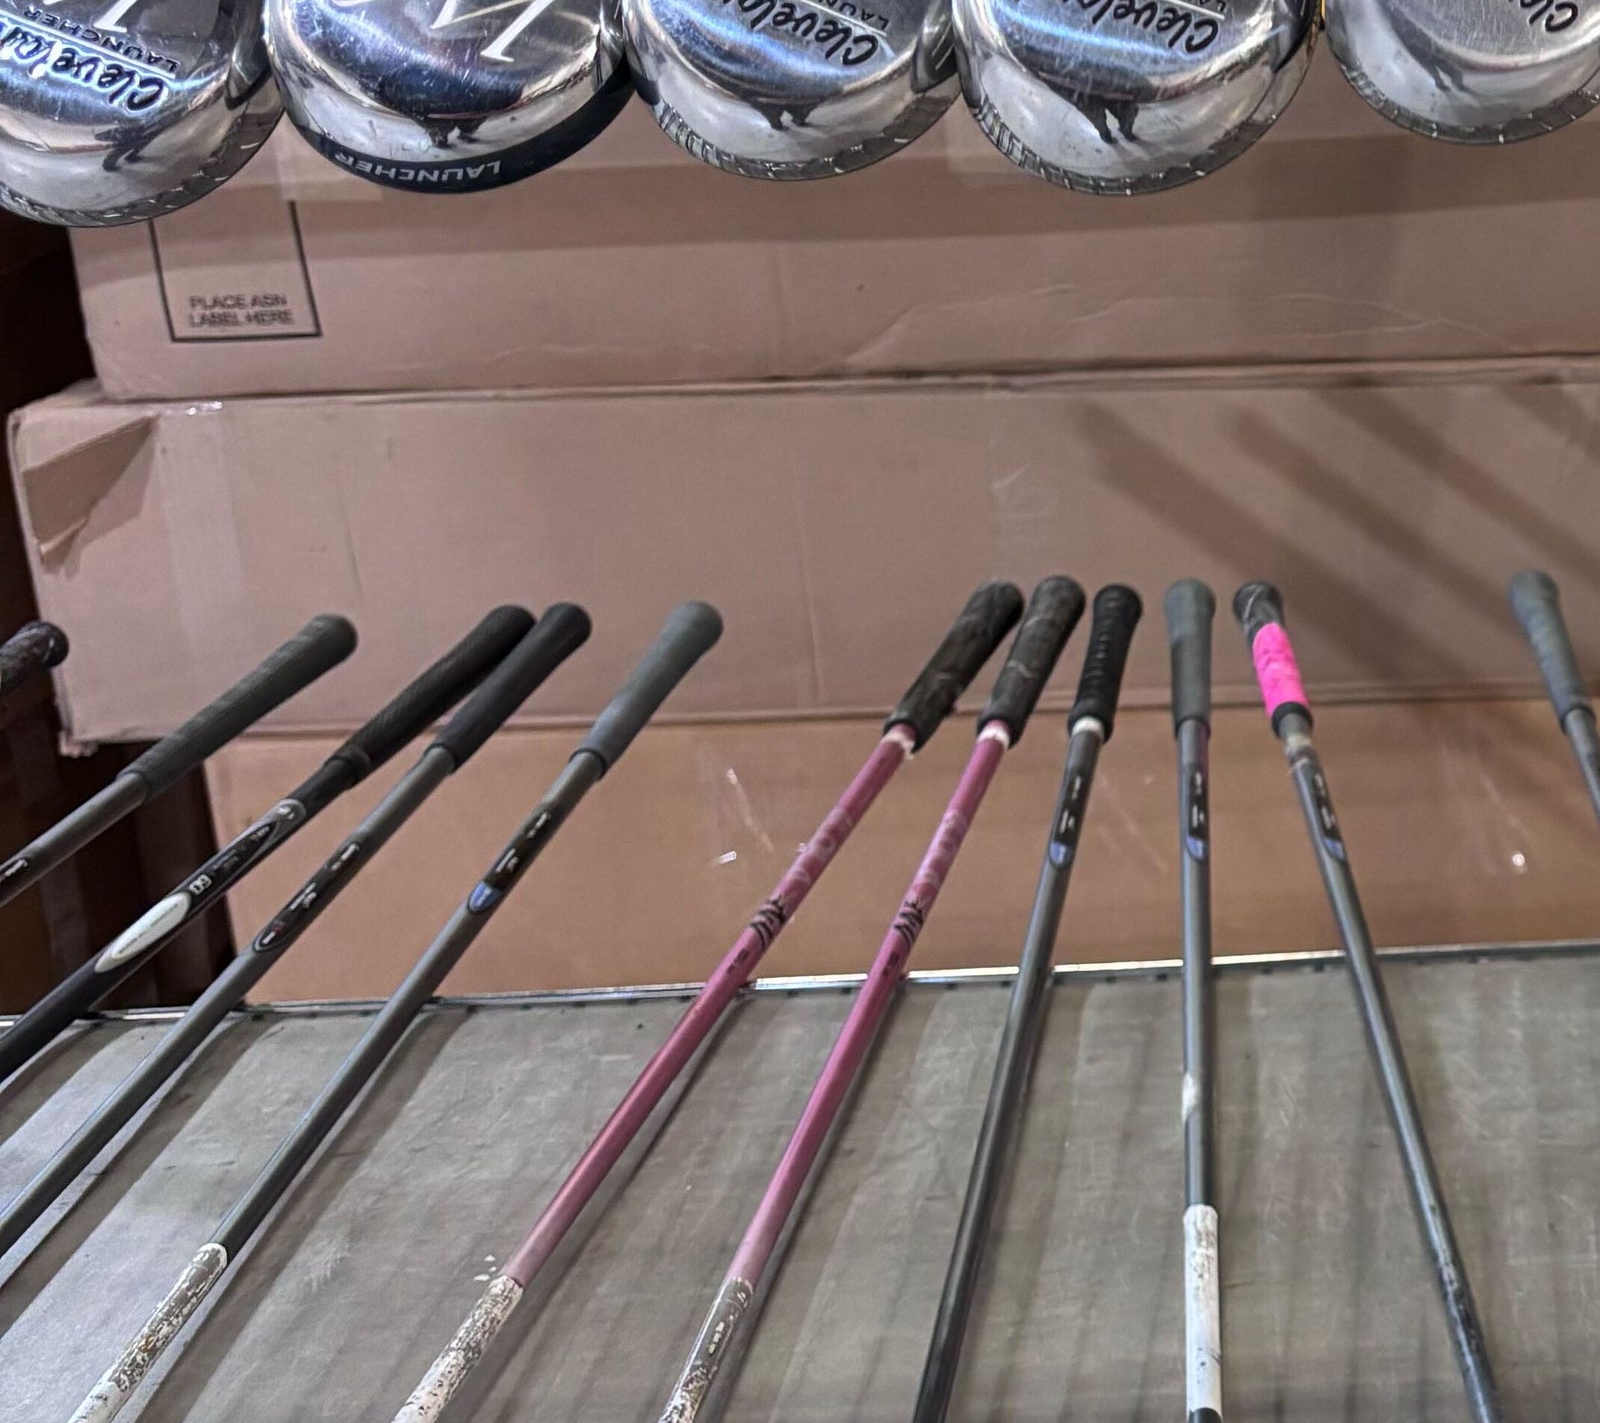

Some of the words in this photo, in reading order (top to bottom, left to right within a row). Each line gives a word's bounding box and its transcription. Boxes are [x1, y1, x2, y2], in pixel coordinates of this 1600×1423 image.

[0, 21, 166, 112] Clevela
[24, 4, 180, 74] LAUNCHER
[334, 152, 501, 182] LAUNCHER
